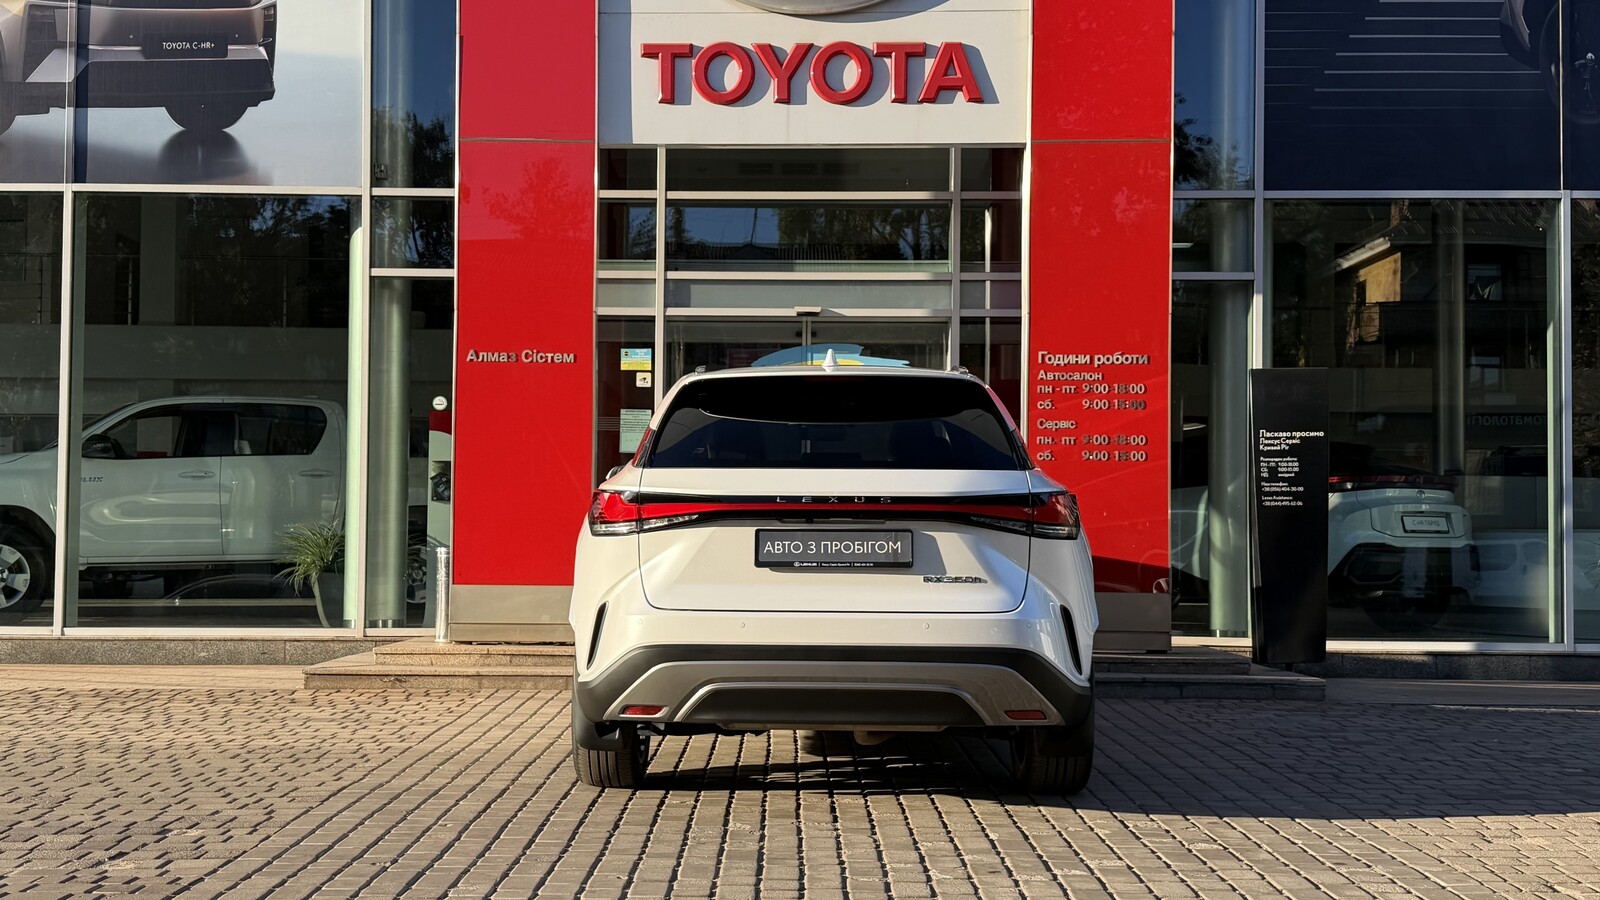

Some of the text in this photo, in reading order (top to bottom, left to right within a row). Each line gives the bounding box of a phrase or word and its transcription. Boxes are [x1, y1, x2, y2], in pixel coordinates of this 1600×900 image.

[162, 42, 215, 50] TOYOTA C-HR+
[641, 41, 984, 105] TOYOTA
[466, 349, 575, 363] Алмаз Сістем
[1038, 351, 1149, 368] Години роботи
[1037, 370, 1103, 380] Автосалон
[1037, 399, 1055, 410] сб.
[1037, 419, 1076, 431] Сервіс
[1260, 430, 1291, 438] Ласкаво
[1036, 450, 1055, 461] сб.
[764, 541, 901, 554] АВТО З ПРОБІГОМ
